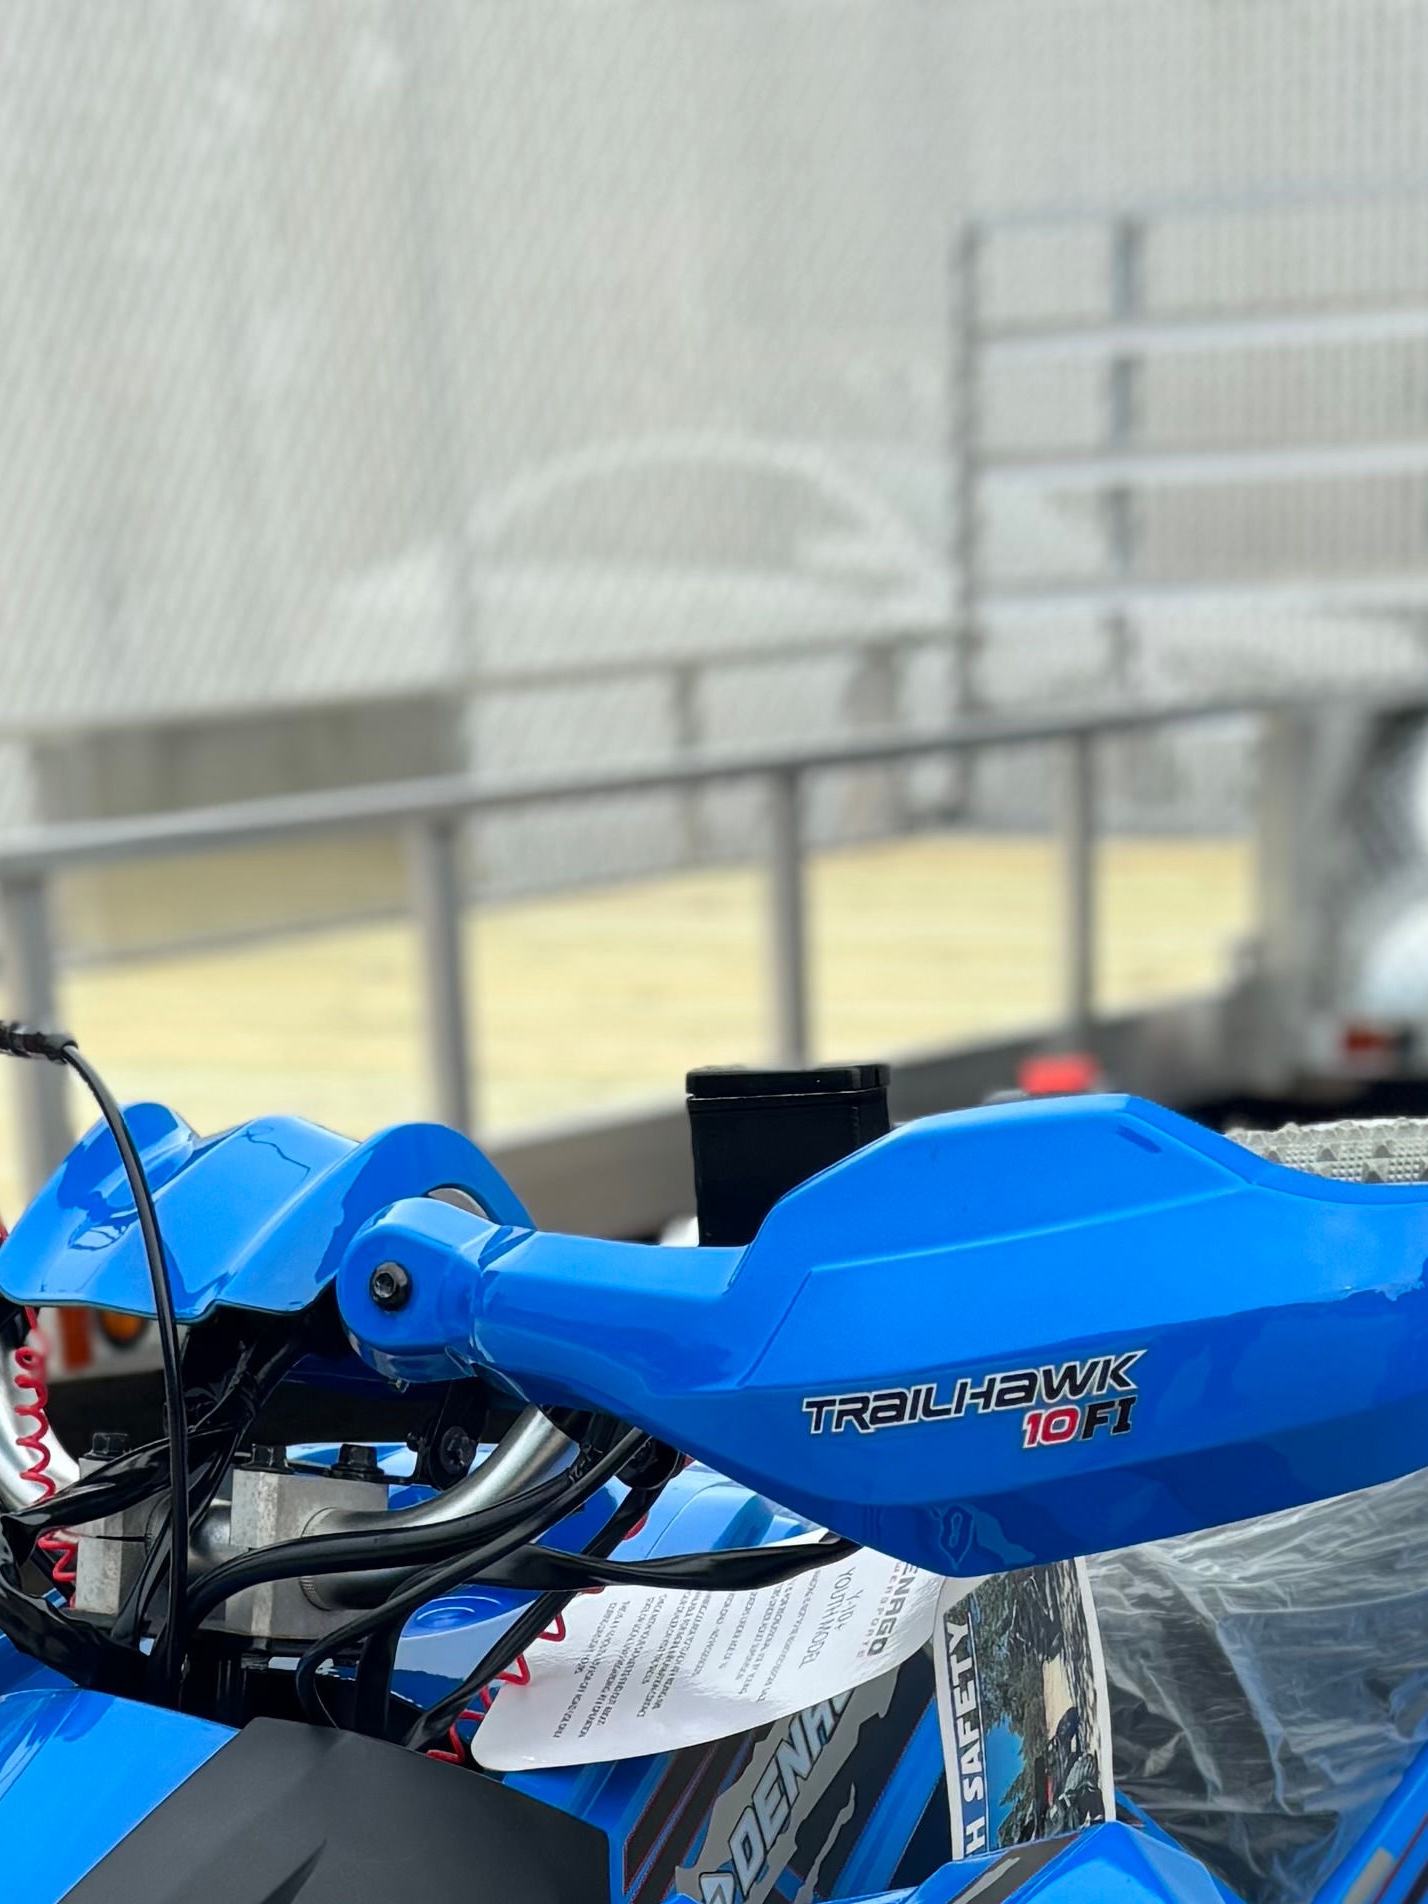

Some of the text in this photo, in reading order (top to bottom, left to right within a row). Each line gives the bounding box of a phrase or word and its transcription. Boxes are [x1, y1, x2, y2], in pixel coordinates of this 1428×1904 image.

[802, 1349, 1148, 1434] TRAILHAWK
[1022, 1395, 1138, 1450] 10FI
[798, 1567, 856, 1669] YOUTH MODEL
[867, 1562, 918, 1657] ENAGO
[946, 1622, 985, 1803] SAFETY
[728, 1688, 856, 1901] DENA
